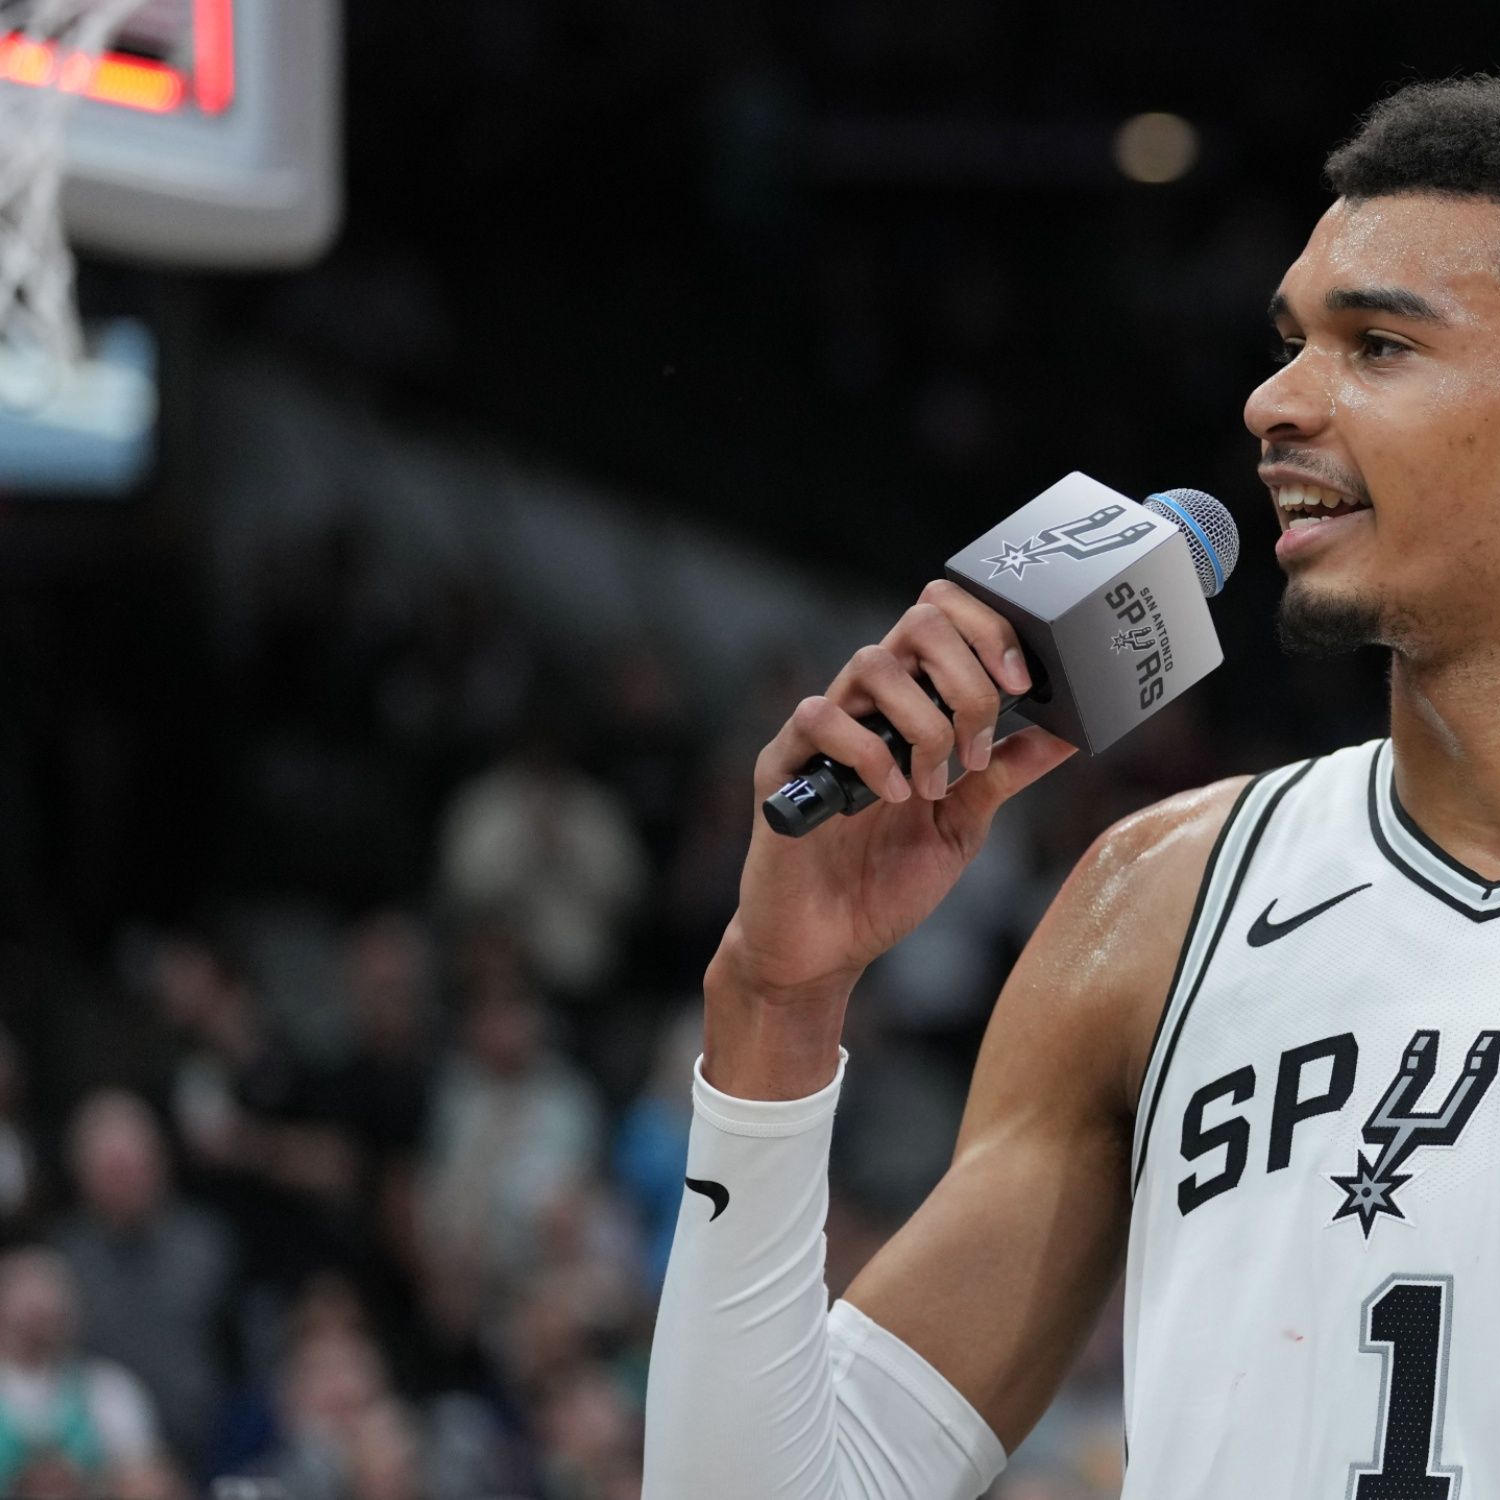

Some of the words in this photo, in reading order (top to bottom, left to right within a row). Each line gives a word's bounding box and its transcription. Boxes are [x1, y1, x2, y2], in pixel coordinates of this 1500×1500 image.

[1104, 582, 1164, 710] SPURS
[1140, 587, 1157, 612] SAN
[1152, 612, 1174, 672] ANTONIO
[1346, 1273, 1462, 1500] 1
